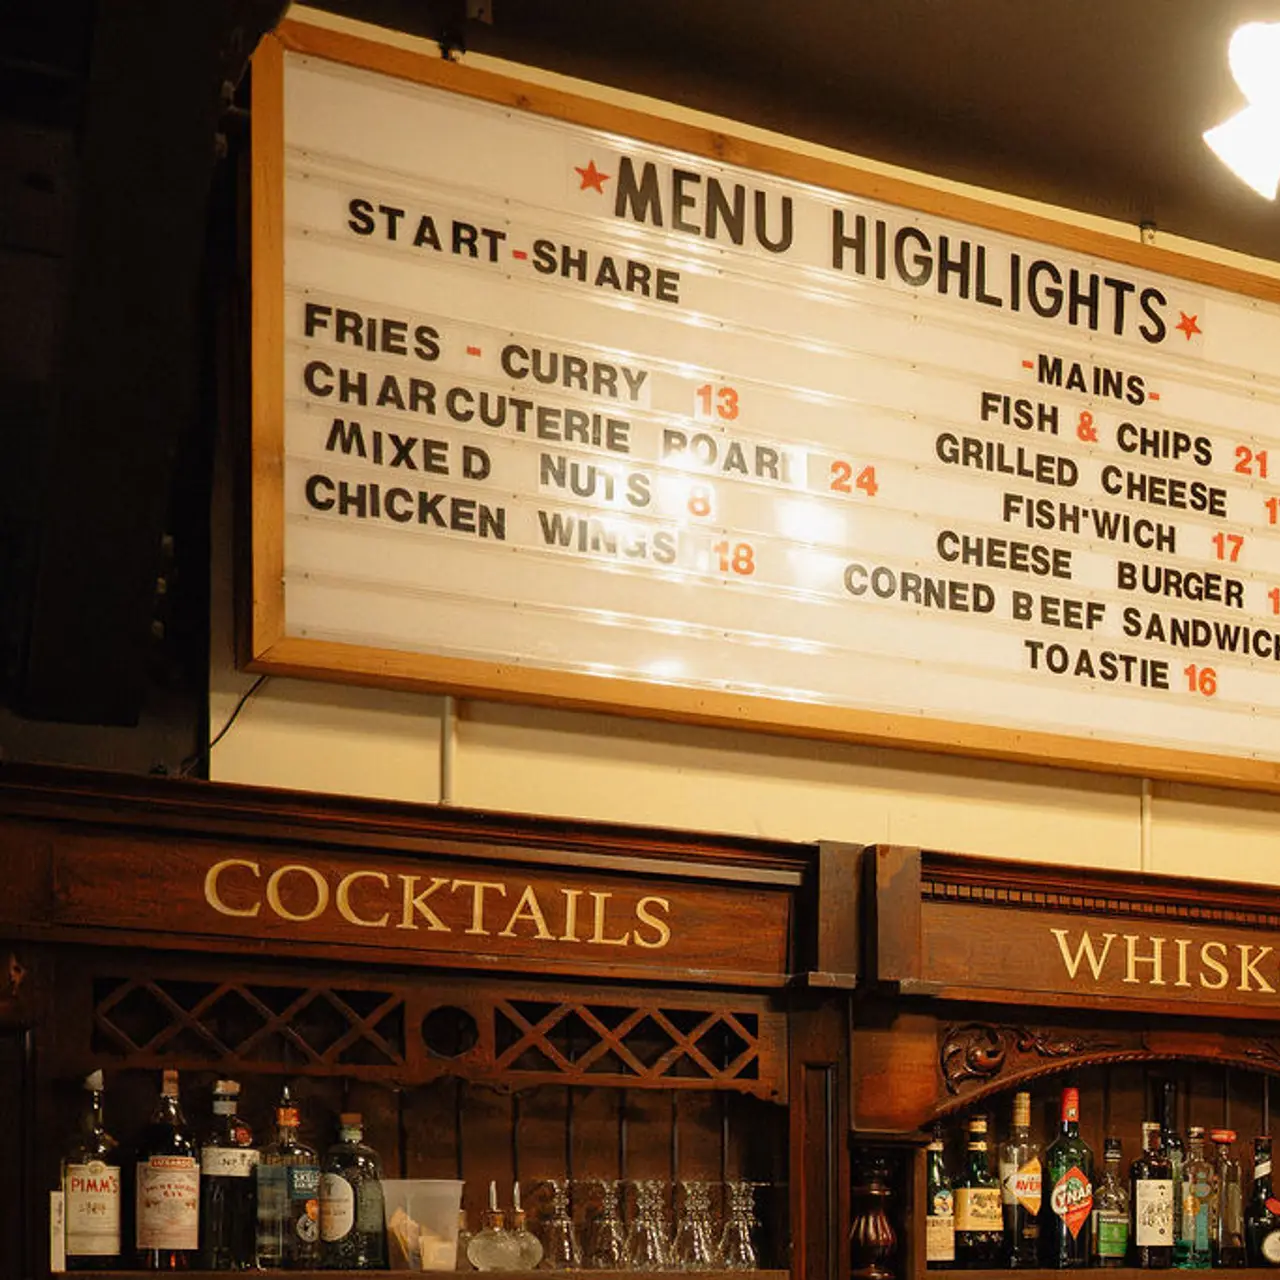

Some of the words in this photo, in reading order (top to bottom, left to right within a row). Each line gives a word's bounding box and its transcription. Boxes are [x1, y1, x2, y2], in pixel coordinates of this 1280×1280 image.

[614, 155, 794, 254] MENU
[832, 210, 1168, 344] HIGHLIGHTS
[304, 301, 441, 361] FRIES
[500, 343, 648, 402] CURRY
[695, 383, 741, 421] 13
[303, 360, 631, 454] CHARCUTERIE
[829, 460, 878, 497] 24
[325, 418, 492, 481] MIXED
[539, 453, 652, 508] NUTS
[686, 480, 712, 518] 8
[980, 390, 1059, 436] FISH
[1075, 410, 1099, 443] &
[1116, 421, 1213, 467] CHIPS
[1233, 445, 1269, 479] 21
[934, 431, 1079, 488] GRILLED
[1100, 464, 1228, 518] CHEESE
[304, 473, 507, 542] CHICKEN
[537, 509, 677, 565] WINGS
[713, 540, 756, 577] 18
[935, 529, 1073, 580] CHEESE
[1117, 560, 1245, 610] BURGER
[1002, 492, 1177, 554] FISH'WICH
[1211, 531, 1245, 563] 17
[842, 561, 996, 615] CORNED
[1011, 590, 1106, 632] BEEF
[1023, 638, 1170, 691] TOASTIE
[1183, 662, 1218, 697] 16
[202, 857, 674, 950] COCKTAILS
[70, 1176, 118, 1194] PIMM'S
